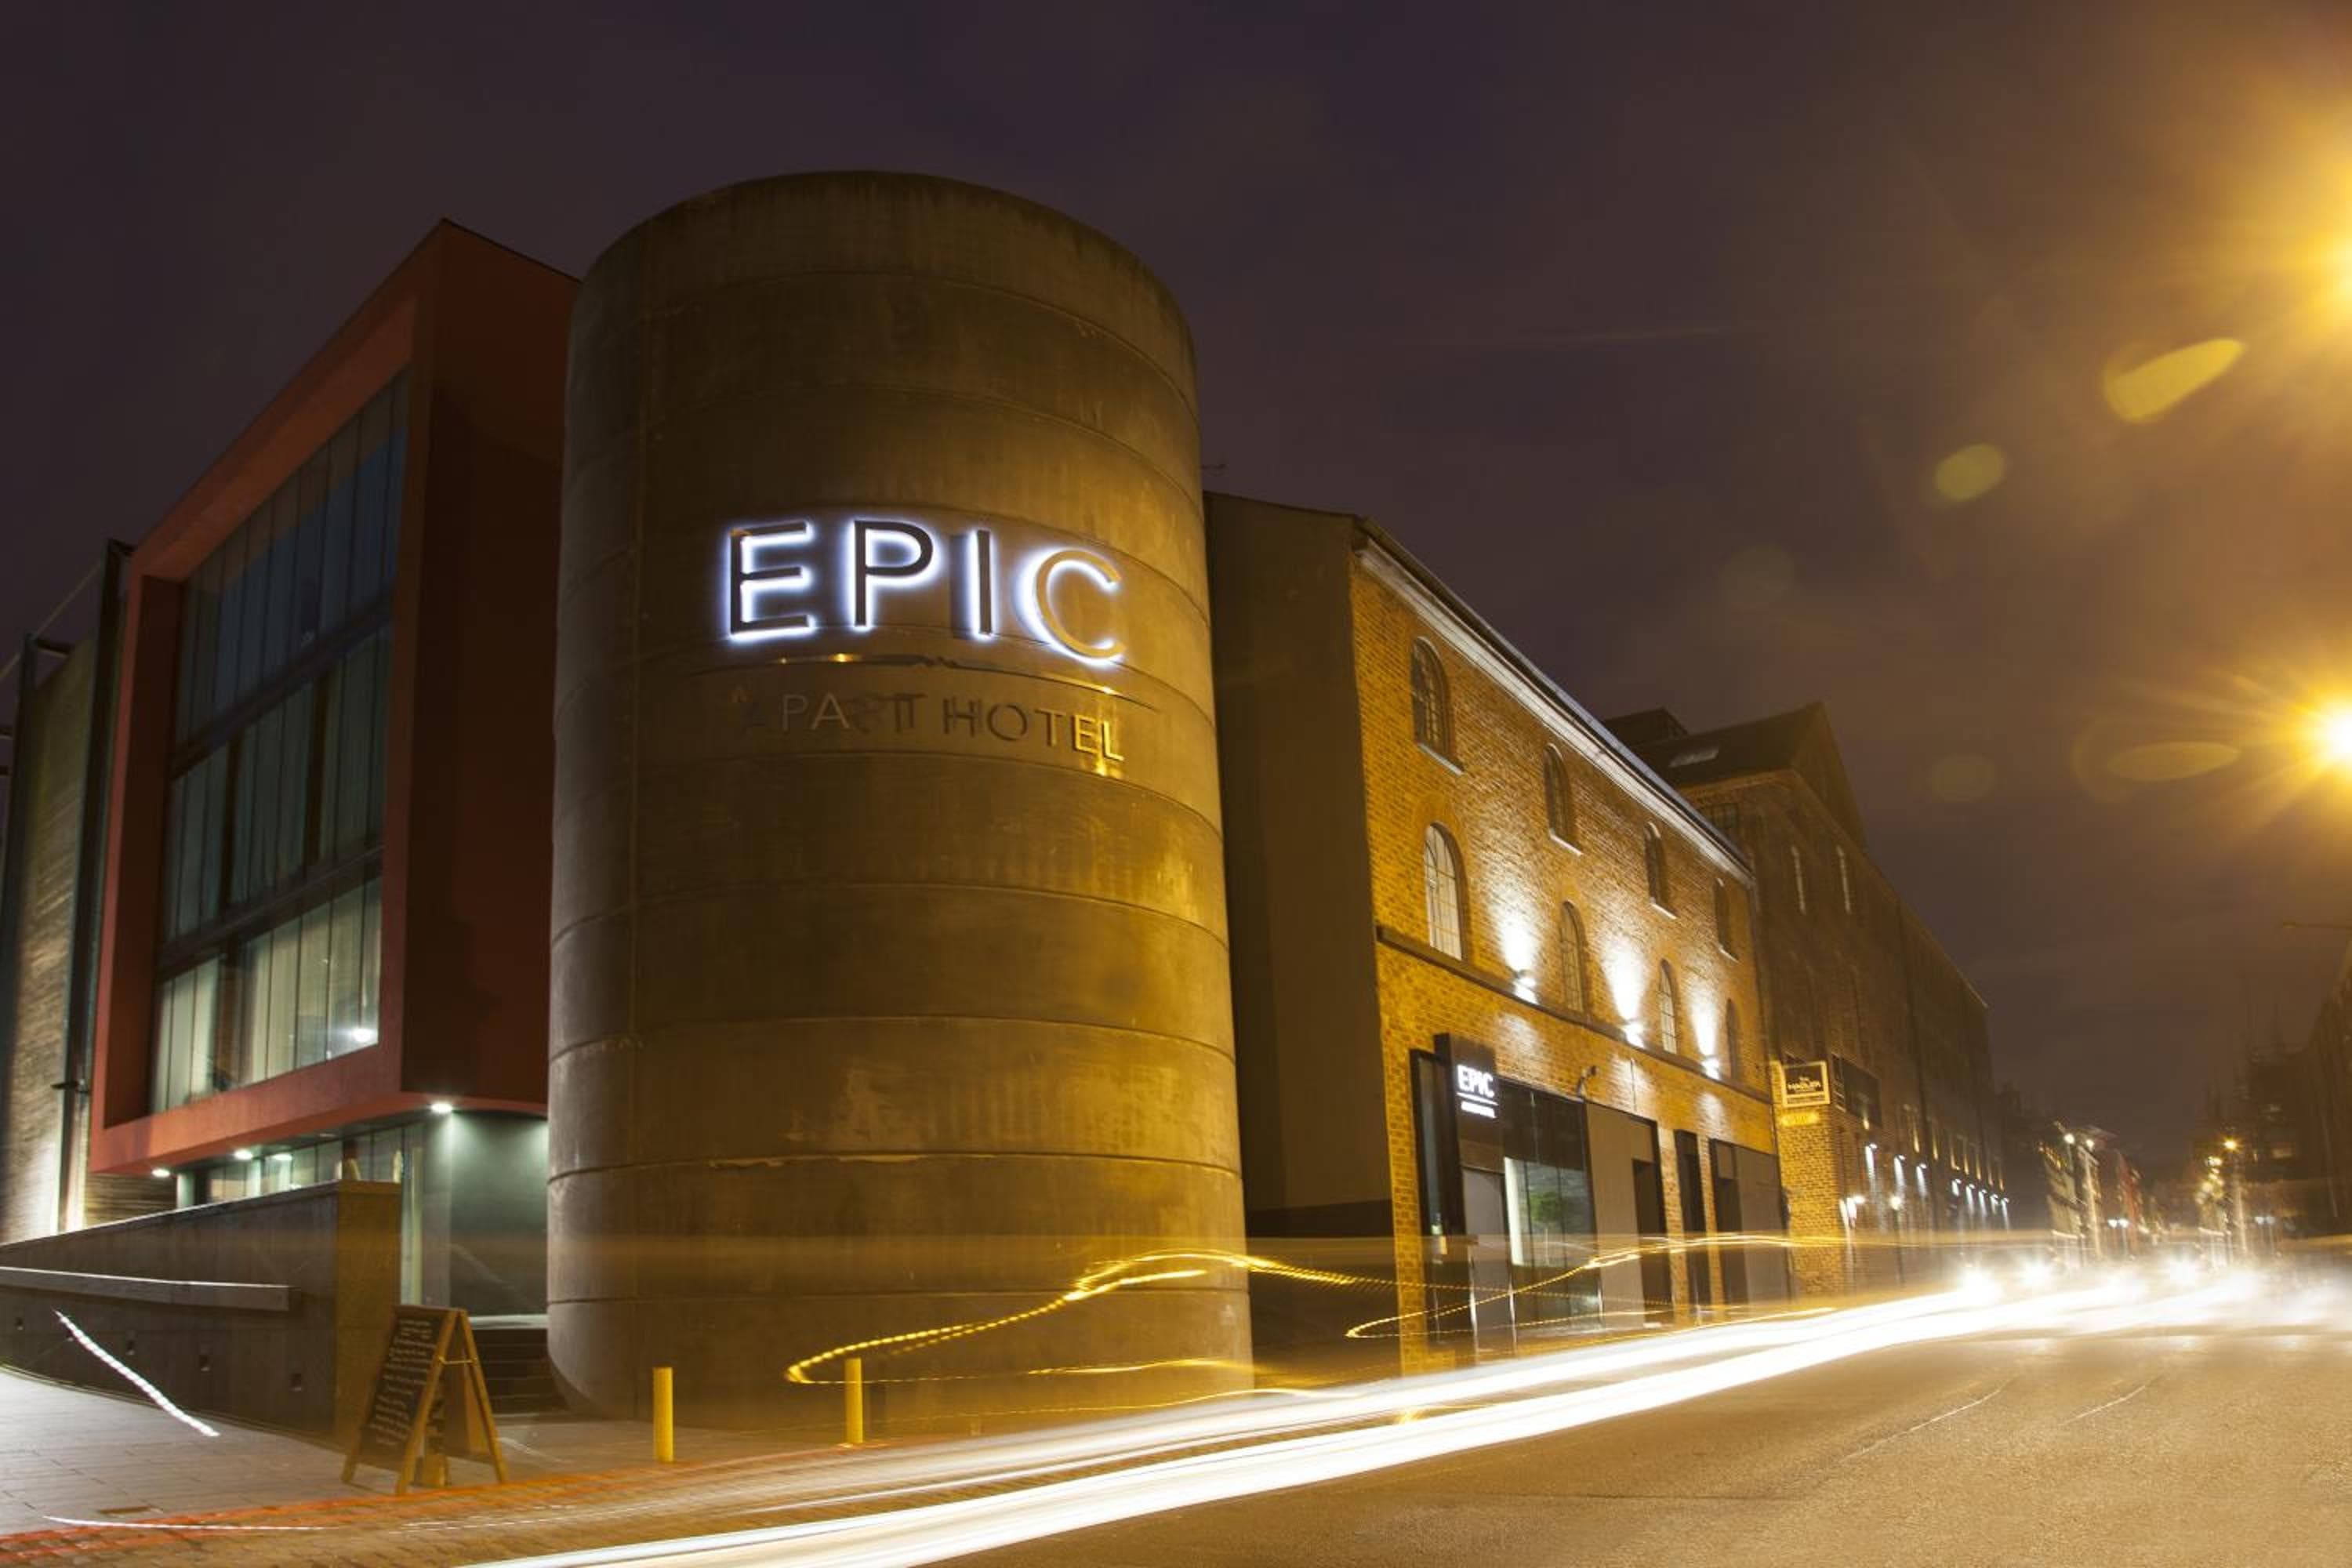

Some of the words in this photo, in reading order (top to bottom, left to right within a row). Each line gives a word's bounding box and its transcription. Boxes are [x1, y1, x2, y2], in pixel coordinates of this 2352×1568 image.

[726, 519, 1126, 666] EPIC
[730, 684, 927, 734] PAT
[943, 697, 1124, 762] HOTEL
[1457, 1064, 1495, 1098] EPIC
